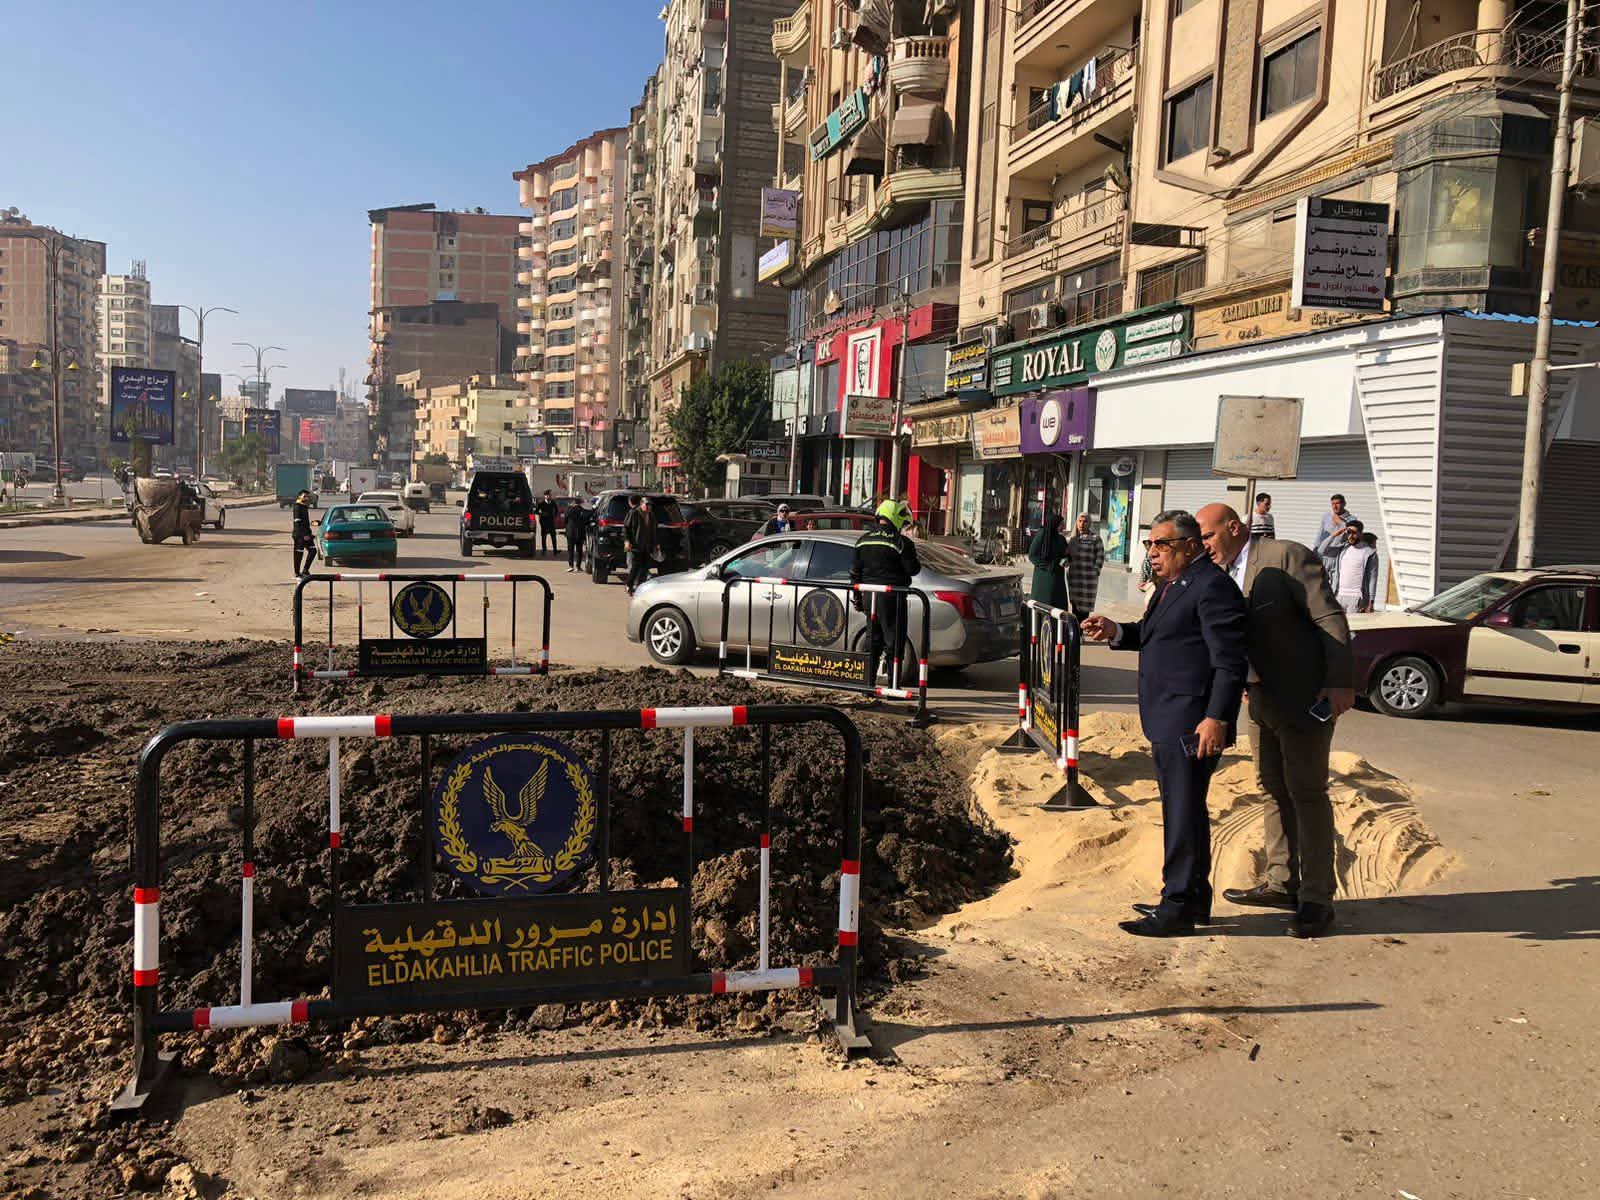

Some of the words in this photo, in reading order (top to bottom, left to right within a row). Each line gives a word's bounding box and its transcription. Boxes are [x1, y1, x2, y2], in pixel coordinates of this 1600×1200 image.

[1350, 246, 1376, 257] نحت
[1346, 265, 1374, 279] علاج
[818, 338, 834, 360] KFC
[1021, 340, 1084, 382] ROYAL
[1042, 416, 1056, 429] WE
[479, 515, 524, 527] POLICE
[775, 649, 821, 666] الدقهلية
[822, 658, 843, 669] مرور
[783, 665, 813, 674] DAKAHLIA
[815, 668, 839, 677] TRAFFIC
[841, 671, 864, 681] POLICE
[611, 905, 677, 938] إدارة
[362, 917, 502, 961] الدقهلية
[506, 919, 603, 949] مرور
[368, 952, 503, 987] ELDAKAHLIA
[508, 944, 594, 972] TRAFFIC
[600, 938, 673, 966] POLICE
